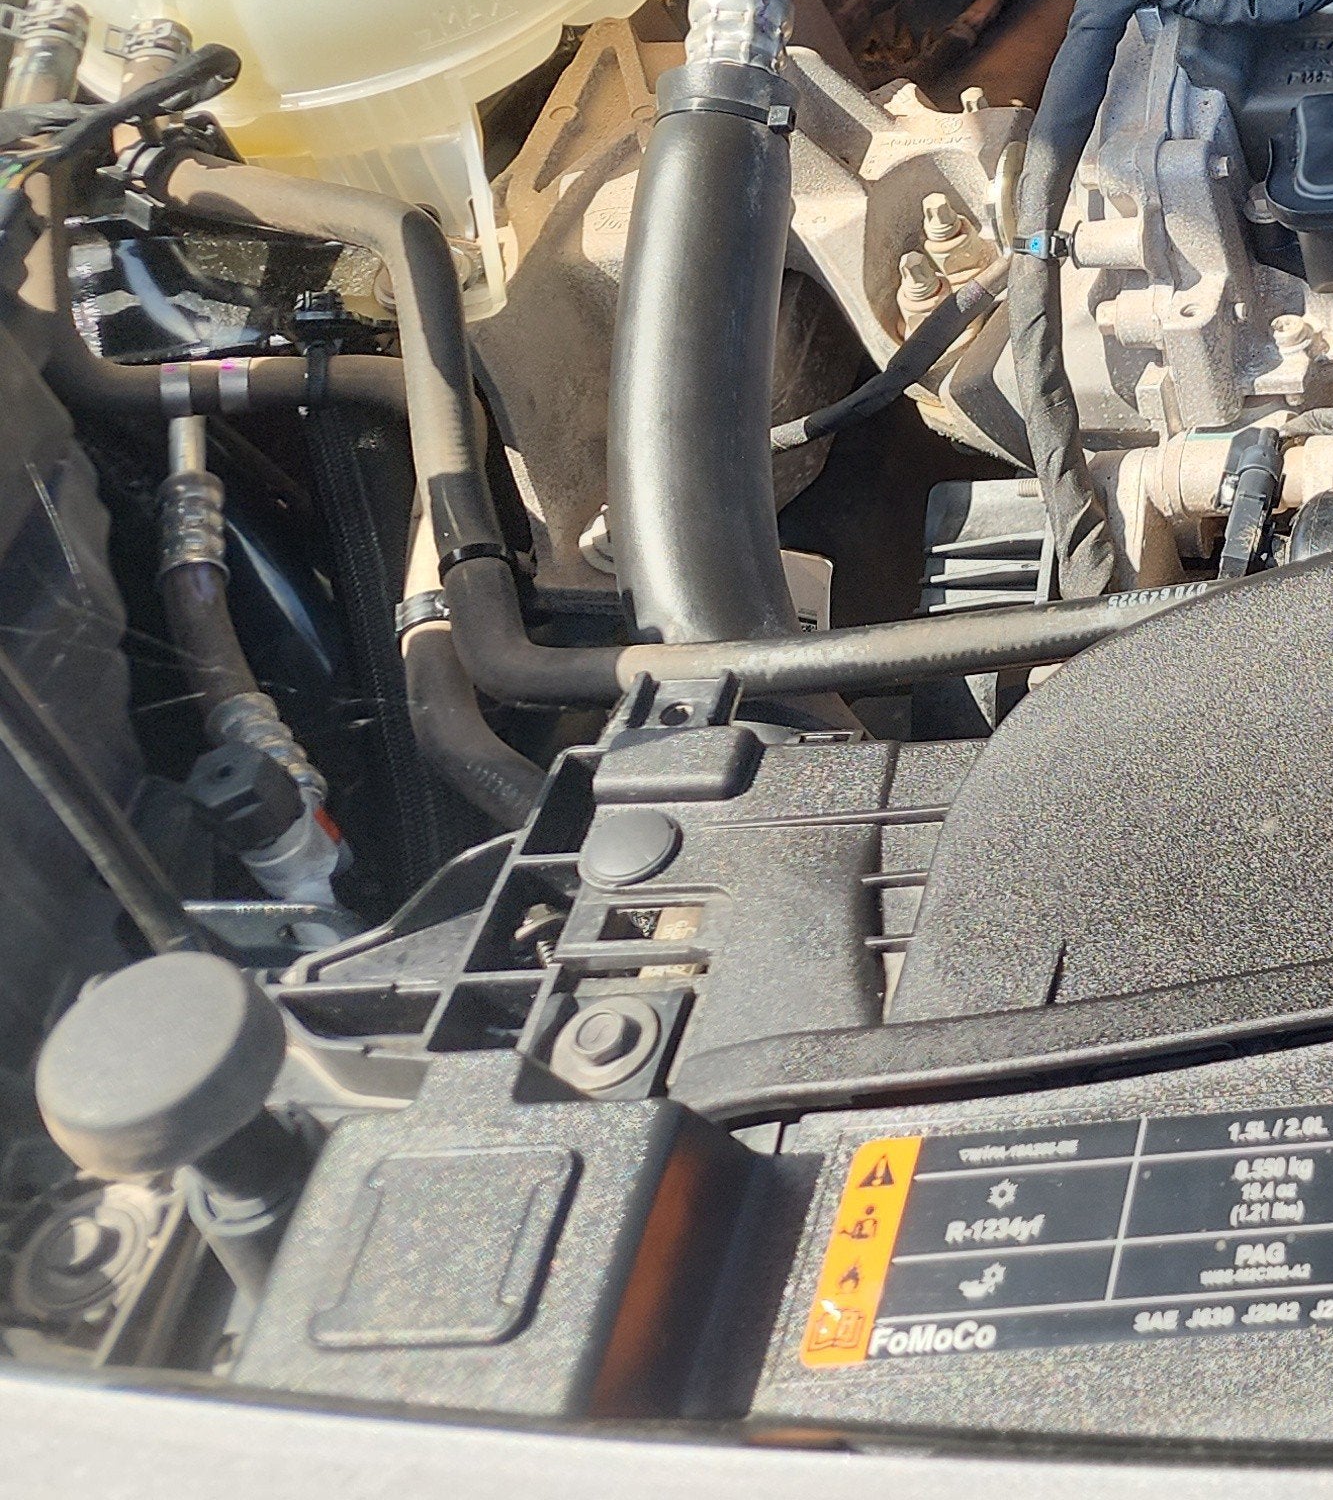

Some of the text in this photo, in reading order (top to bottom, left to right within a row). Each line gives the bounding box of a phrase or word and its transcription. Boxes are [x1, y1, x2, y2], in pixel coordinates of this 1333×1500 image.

[1288, 1155, 1315, 1183] kg
[1275, 1183, 1298, 1199] oz
[945, 1213, 1046, 1244] R-1234yf
[1235, 1242, 1286, 1266] PAG
[1133, 1309, 1180, 1333] SAE
[868, 1320, 997, 1357] FoMoCo
